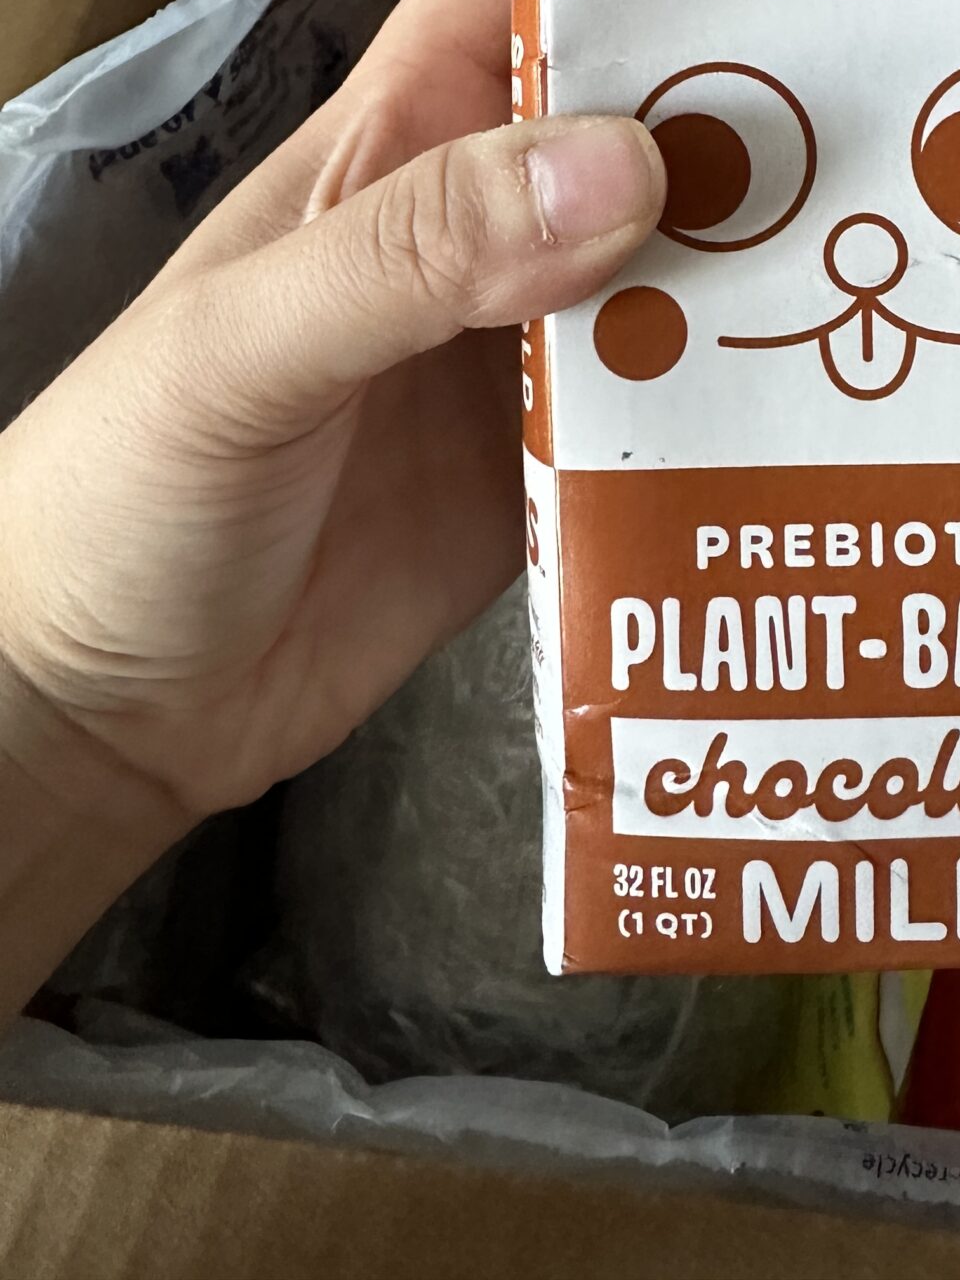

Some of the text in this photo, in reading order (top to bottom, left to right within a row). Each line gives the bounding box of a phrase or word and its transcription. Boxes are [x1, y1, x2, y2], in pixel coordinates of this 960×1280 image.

[613, 864, 716, 899] 32 FL OZ
[618, 909, 712, 939] (1 QT)
